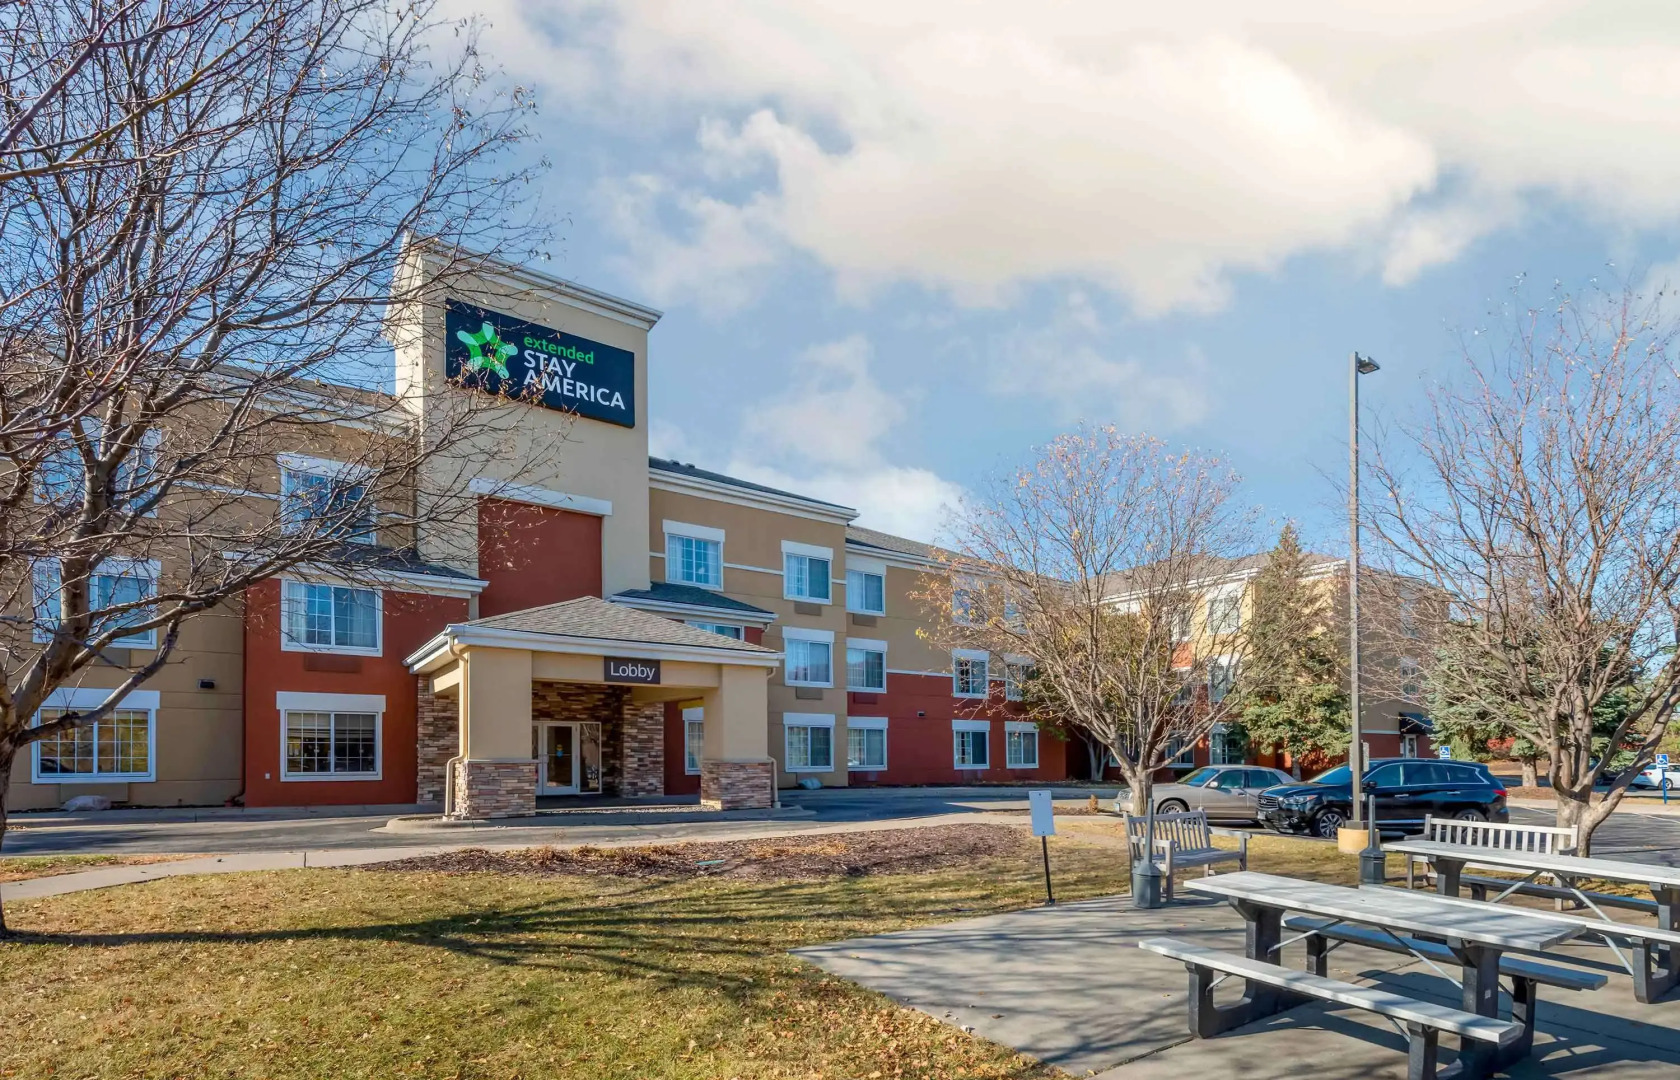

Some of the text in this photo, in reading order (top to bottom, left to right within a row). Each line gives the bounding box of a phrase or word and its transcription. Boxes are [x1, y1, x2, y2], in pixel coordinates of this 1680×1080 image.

[523, 336, 594, 365] extended
[523, 349, 577, 378] STAY
[523, 369, 626, 411] AMERICA
[610, 661, 656, 681] Lobby
